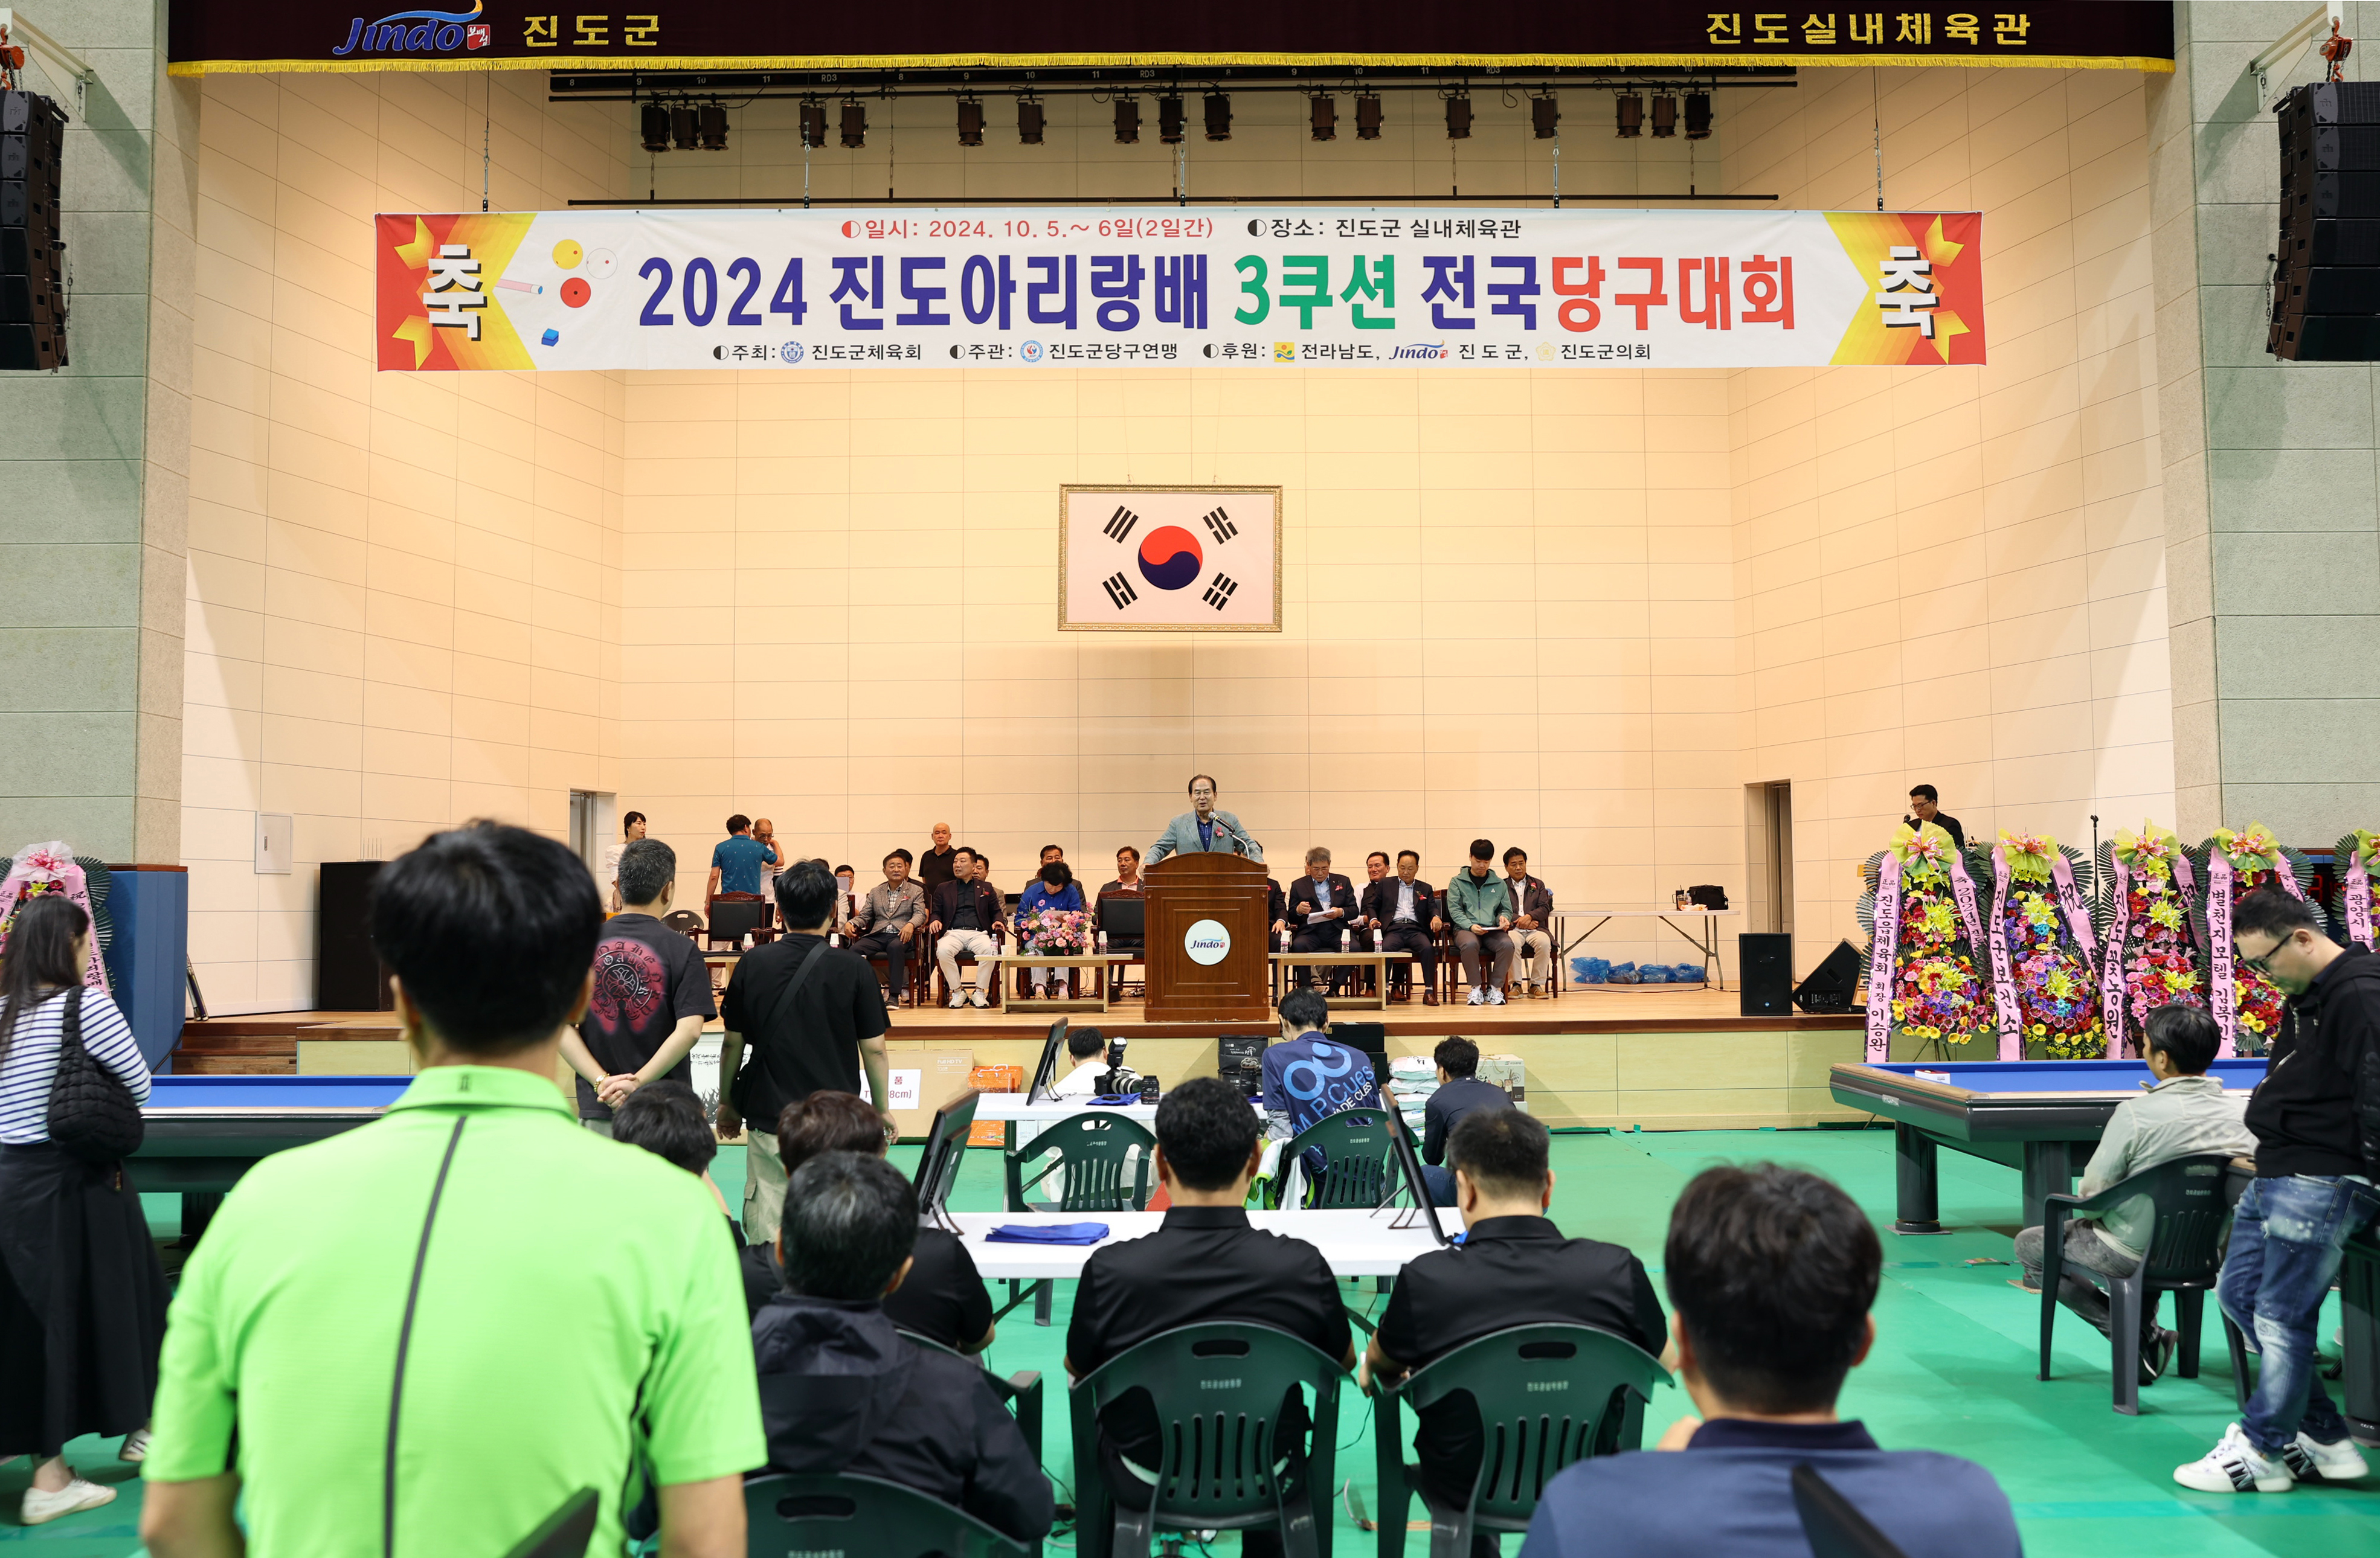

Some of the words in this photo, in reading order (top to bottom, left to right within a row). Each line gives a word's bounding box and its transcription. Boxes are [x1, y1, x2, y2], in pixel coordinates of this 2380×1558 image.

[333, 18, 465, 55] Jindo
[523, 15, 659, 46] 진도군
[1706, 13, 2030, 45] 진도실내체육관
[866, 220, 917, 239] 일시:
[930, 220, 992, 237] 2024.
[1005, 220, 1037, 237] 10.
[1099, 218, 1212, 238] 6일(2일간)
[1272, 219, 1323, 237] 장소:
[1336, 219, 1401, 237] 진도군
[1410, 219, 1521, 239] 실내체육관
[423, 244, 487, 342] 축
[638, 257, 807, 327] 2024
[829, 254, 1208, 332] 진도아리랑배
[1234, 255, 1395, 330] 3쿠션
[1875, 246, 1940, 339] 축
[732, 345, 775, 361] 주최:
[812, 344, 920, 360] 진도군체육회
[969, 344, 1012, 359] 주관:
[1050, 344, 1177, 359] 진도군당구연맹
[1222, 343, 1265, 359] 후원:
[1302, 344, 1379, 360] 전라남도,
[1389, 346, 1438, 359] Jindo
[1561, 344, 1650, 359] 진도군의회
[2349, 894, 2369, 929] 광양시
[1190, 940, 1220, 949] Jindo
[1874, 894, 1894, 975] 진도읍체육회
[2211, 889, 2229, 980] 별천지모텔
[1991, 888, 2018, 1035] 진도군보건소
[2106, 890, 2126, 1039] 진도꽃농원
[1874, 982, 1886, 1002] 회장
[1869, 1008, 1886, 1051] 이승완
